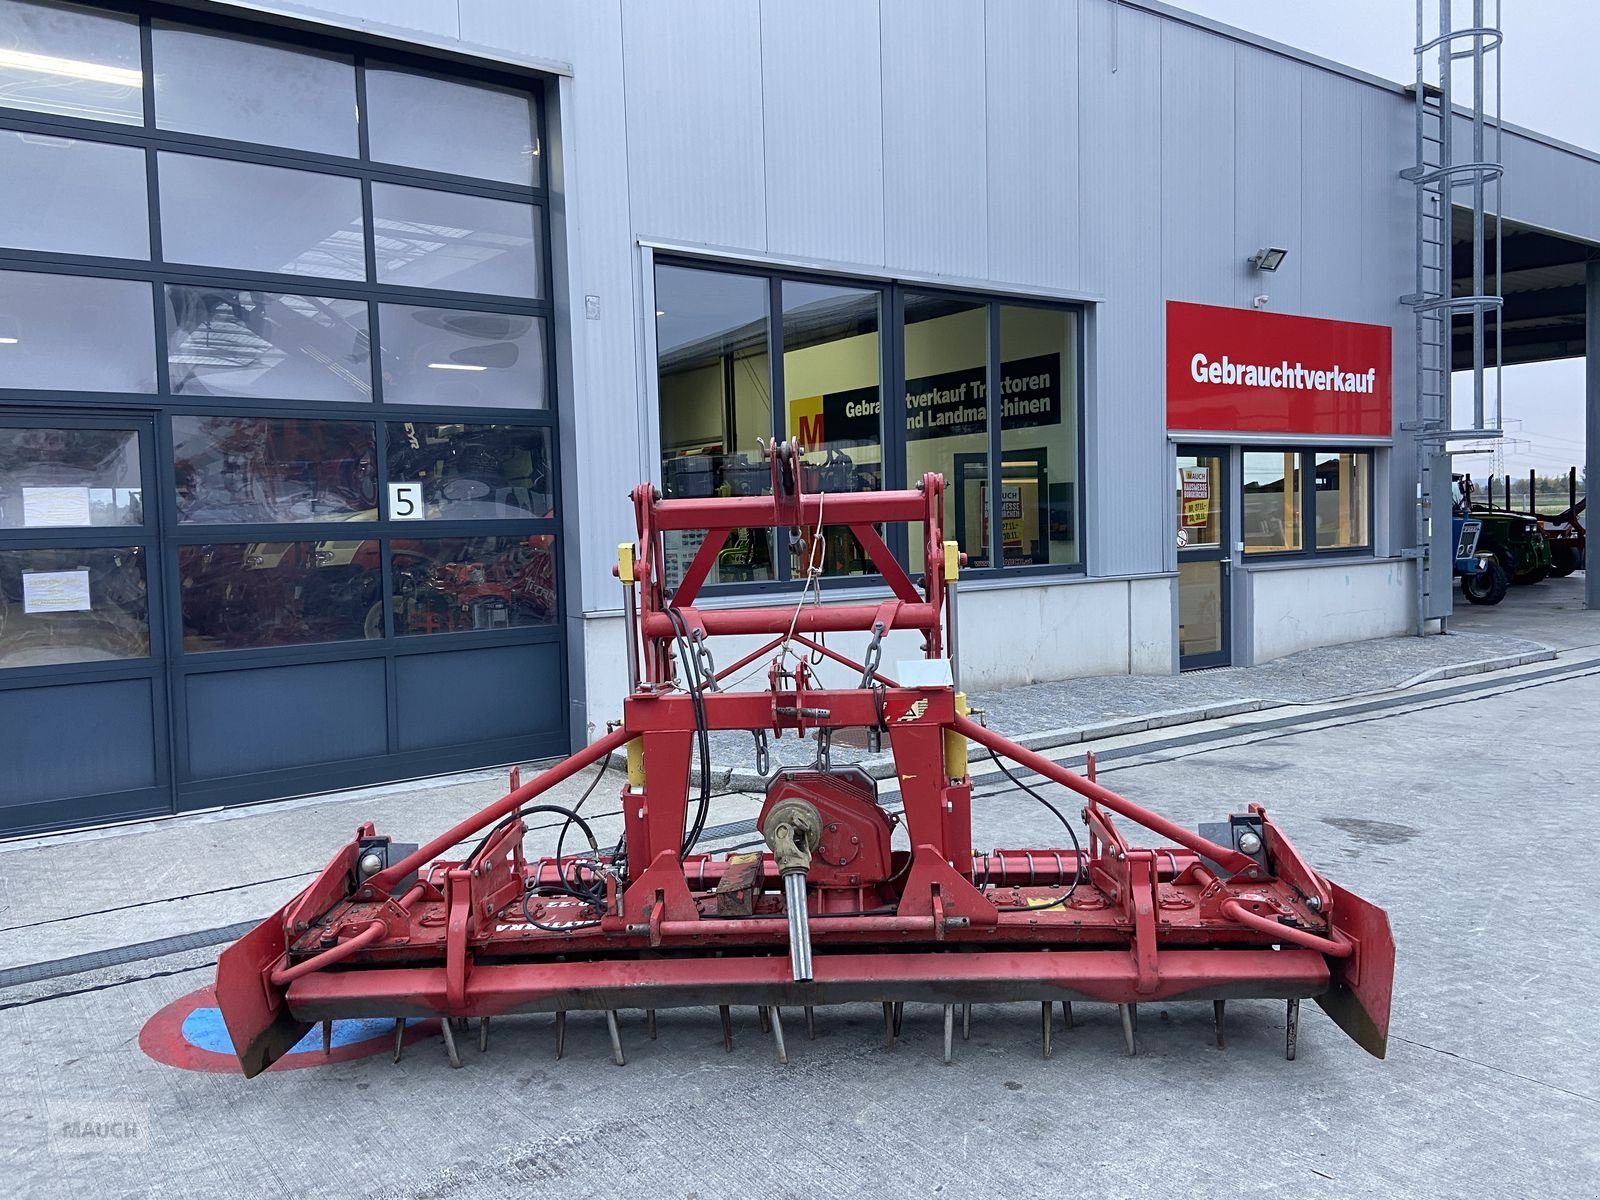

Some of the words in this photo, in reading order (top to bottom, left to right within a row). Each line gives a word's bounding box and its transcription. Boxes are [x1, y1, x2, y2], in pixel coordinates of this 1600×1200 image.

[1191, 353, 1375, 393] Gebrauchtverkauf
[906, 411, 924, 430] nd
[928, 397, 1050, 428] Landmahinen
[396, 488, 414, 516] 5
